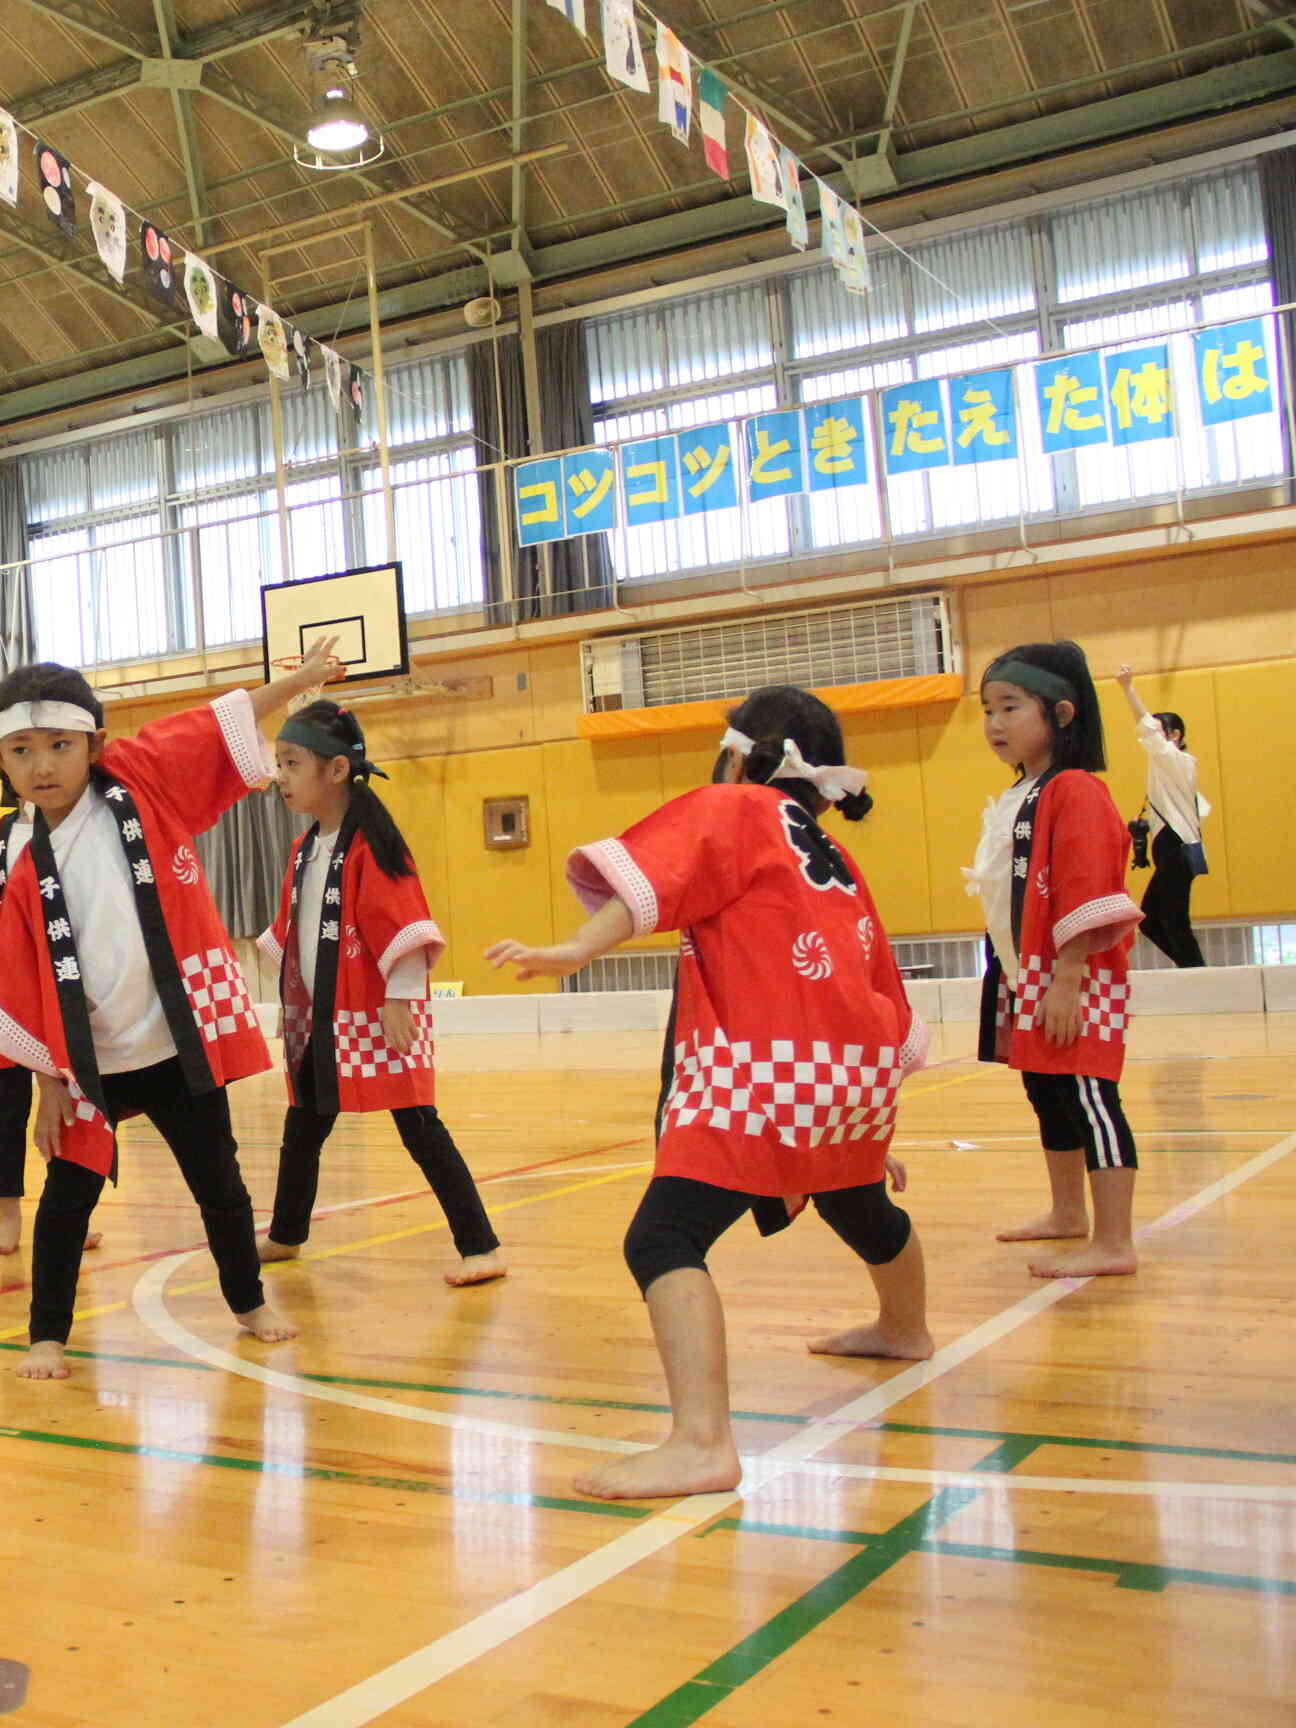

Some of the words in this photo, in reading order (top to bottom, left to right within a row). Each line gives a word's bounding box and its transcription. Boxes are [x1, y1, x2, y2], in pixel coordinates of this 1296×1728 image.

[517, 339, 1268, 526] コツコツときたえた体は
